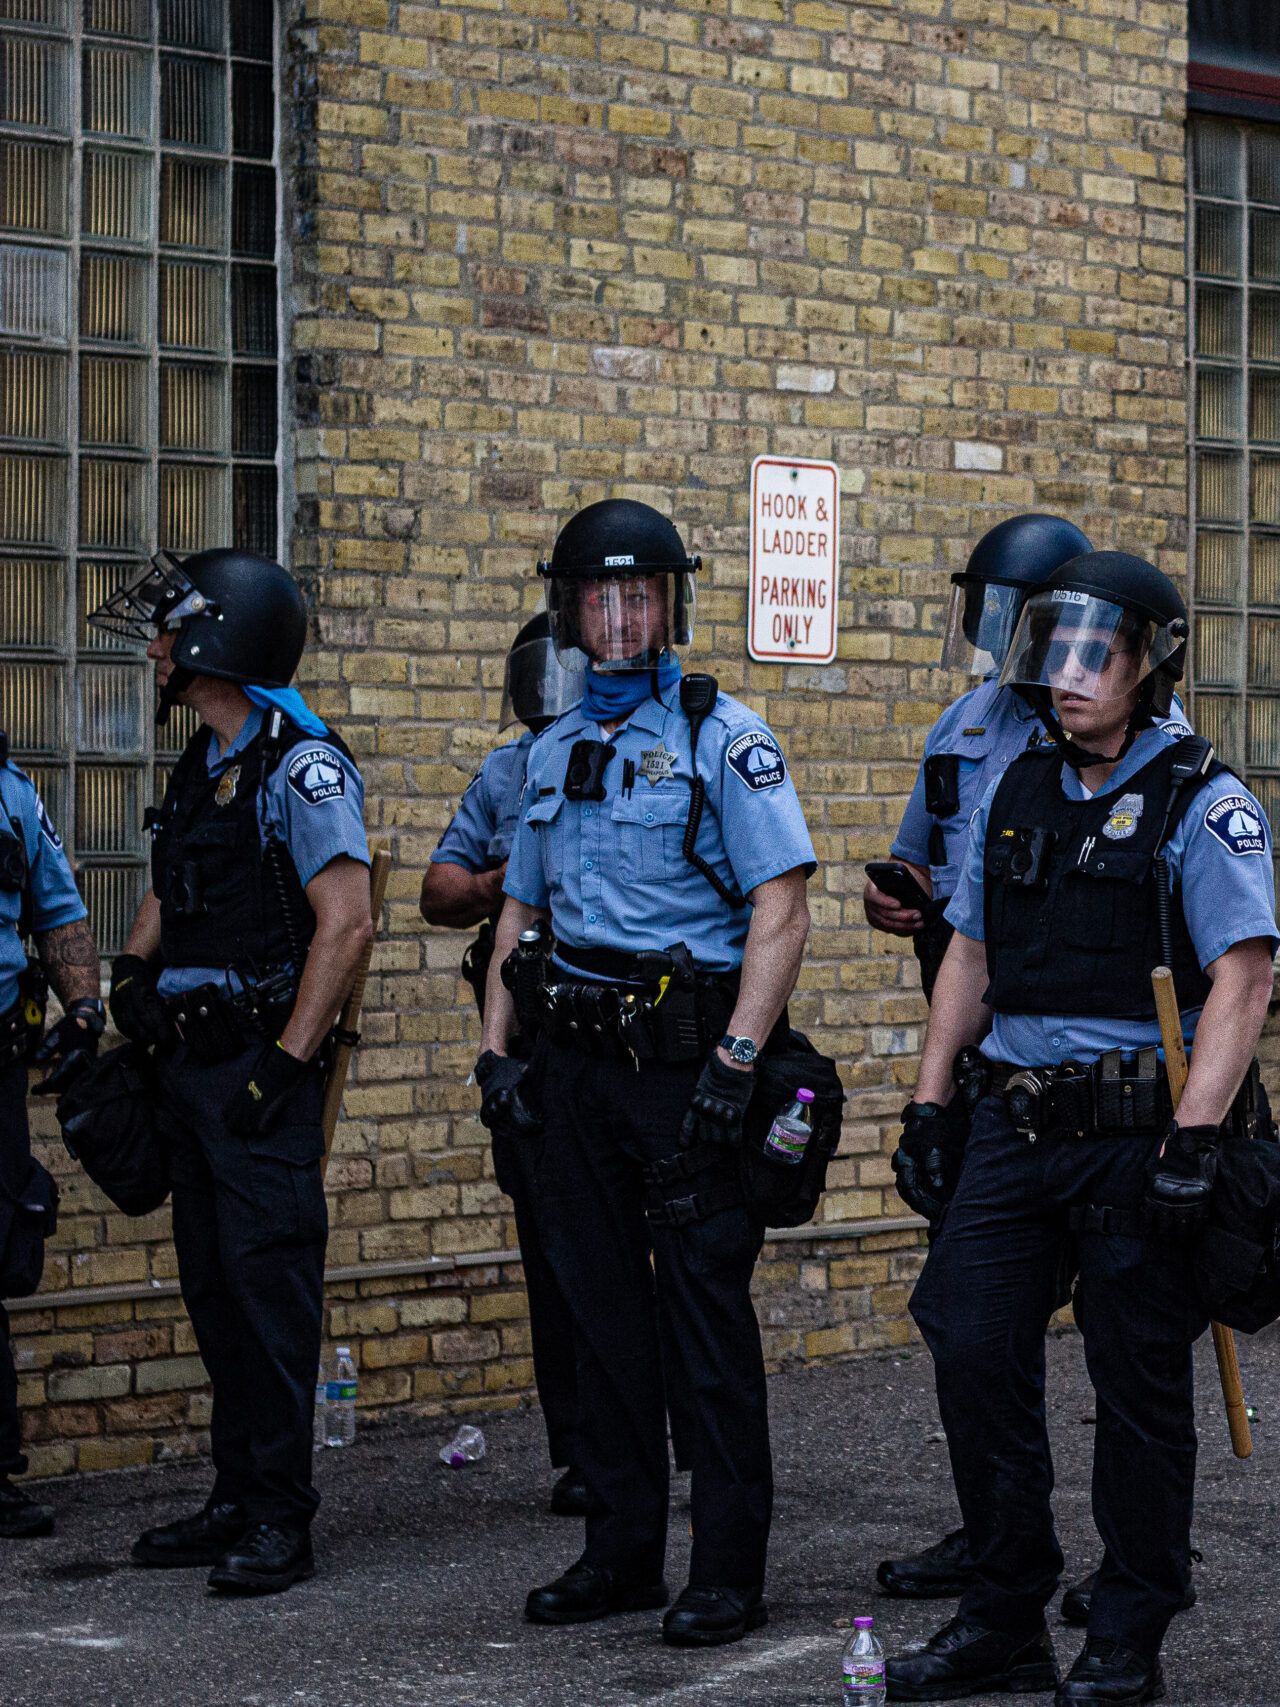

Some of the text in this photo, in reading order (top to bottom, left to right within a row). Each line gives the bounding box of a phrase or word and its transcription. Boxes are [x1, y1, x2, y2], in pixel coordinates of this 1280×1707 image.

[762, 492, 829, 522] HOOK &
[762, 528, 828, 558] LADDER
[606, 557, 634, 566] 1521
[760, 576, 827, 609] PARKING
[1054, 590, 1082, 601] 0516
[772, 614, 814, 645] ONLY
[643, 751, 674, 762] POLICE
[728, 734, 777, 760] MINNEAPOLIS
[289, 752, 341, 778] MINNEAPOLIS
[646, 760, 665, 769] 1521
[754, 771, 782, 785] POLICE
[312, 785, 342, 800] POLICE
[1207, 798, 1259, 823] MINNEAPOLIS
[1236, 839, 1264, 850] POLICE
